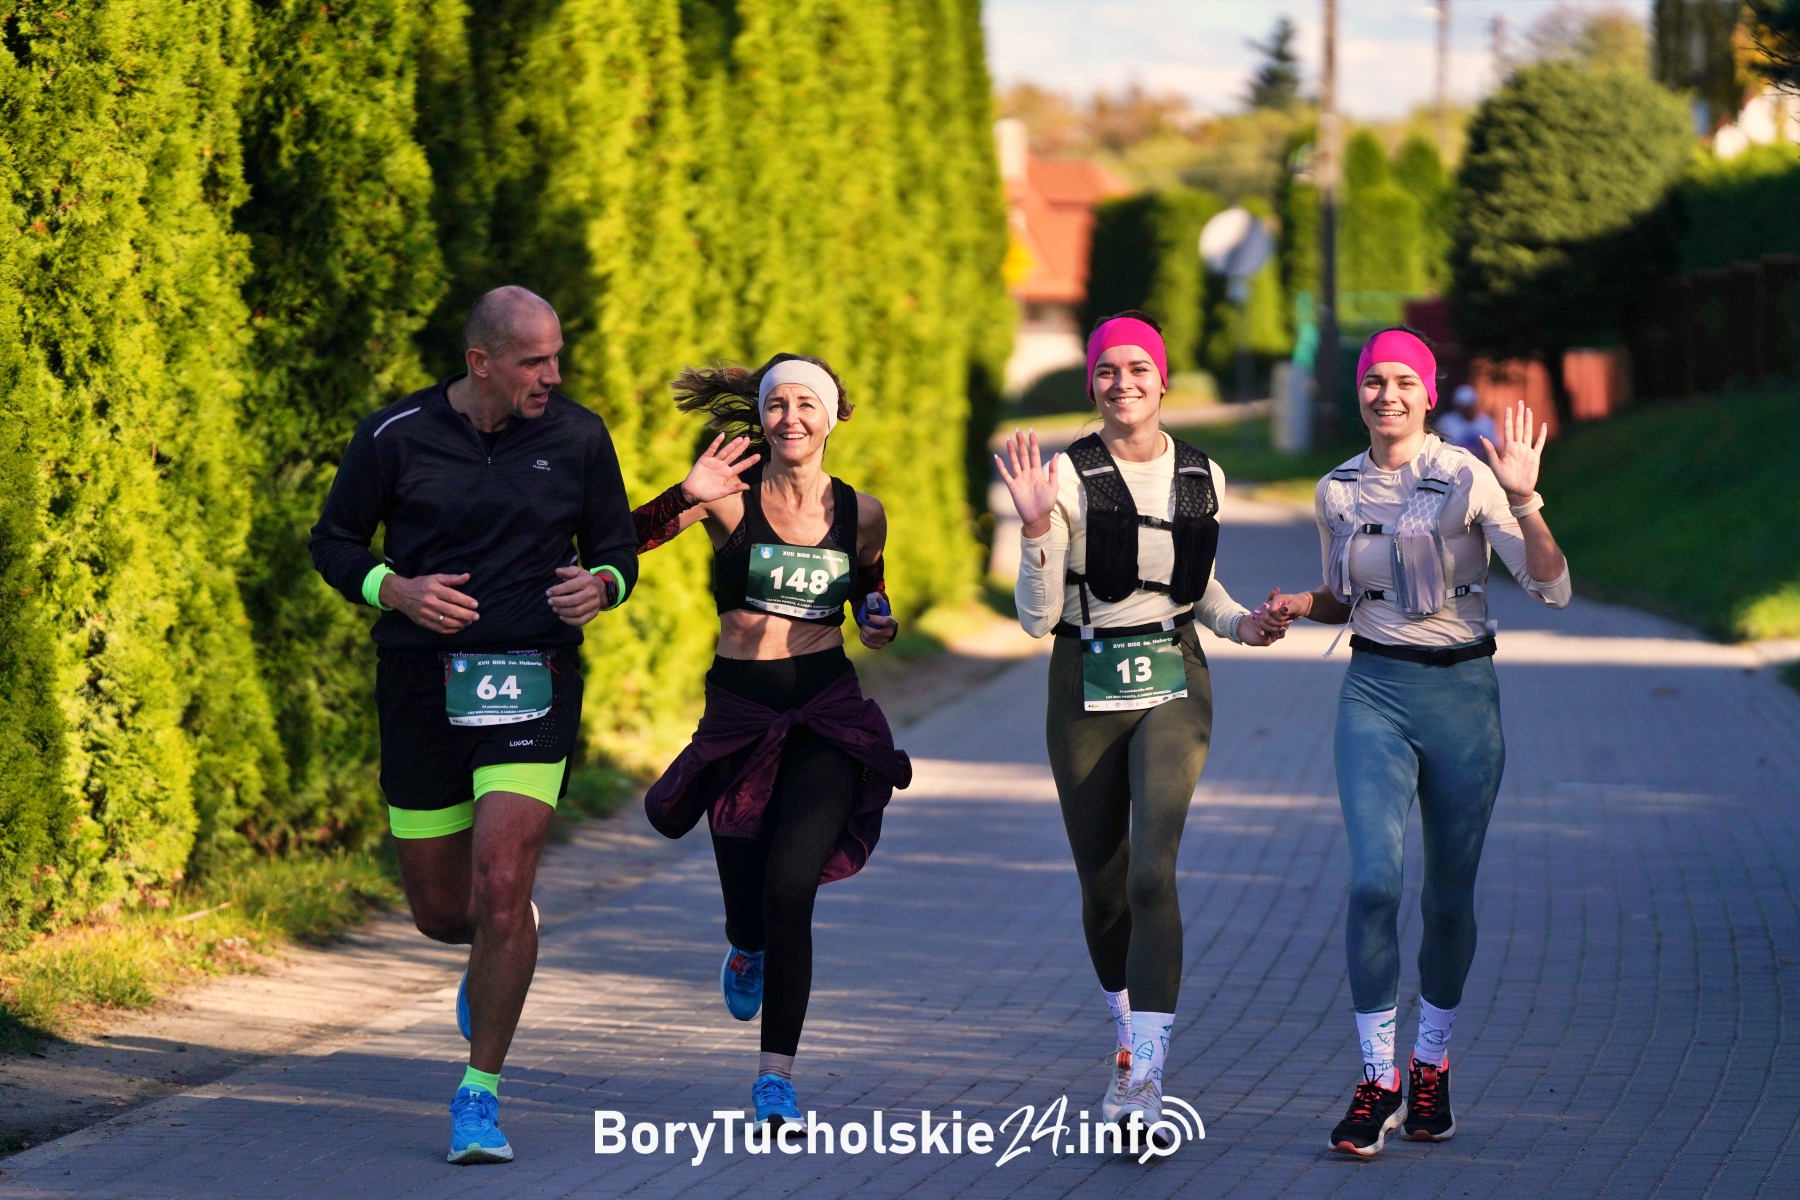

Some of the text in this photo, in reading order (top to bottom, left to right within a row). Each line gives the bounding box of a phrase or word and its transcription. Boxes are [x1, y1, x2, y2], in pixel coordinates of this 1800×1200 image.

[770, 566, 829, 595] 148
[1117, 656, 1152, 684] 13
[476, 675, 522, 700] 64
